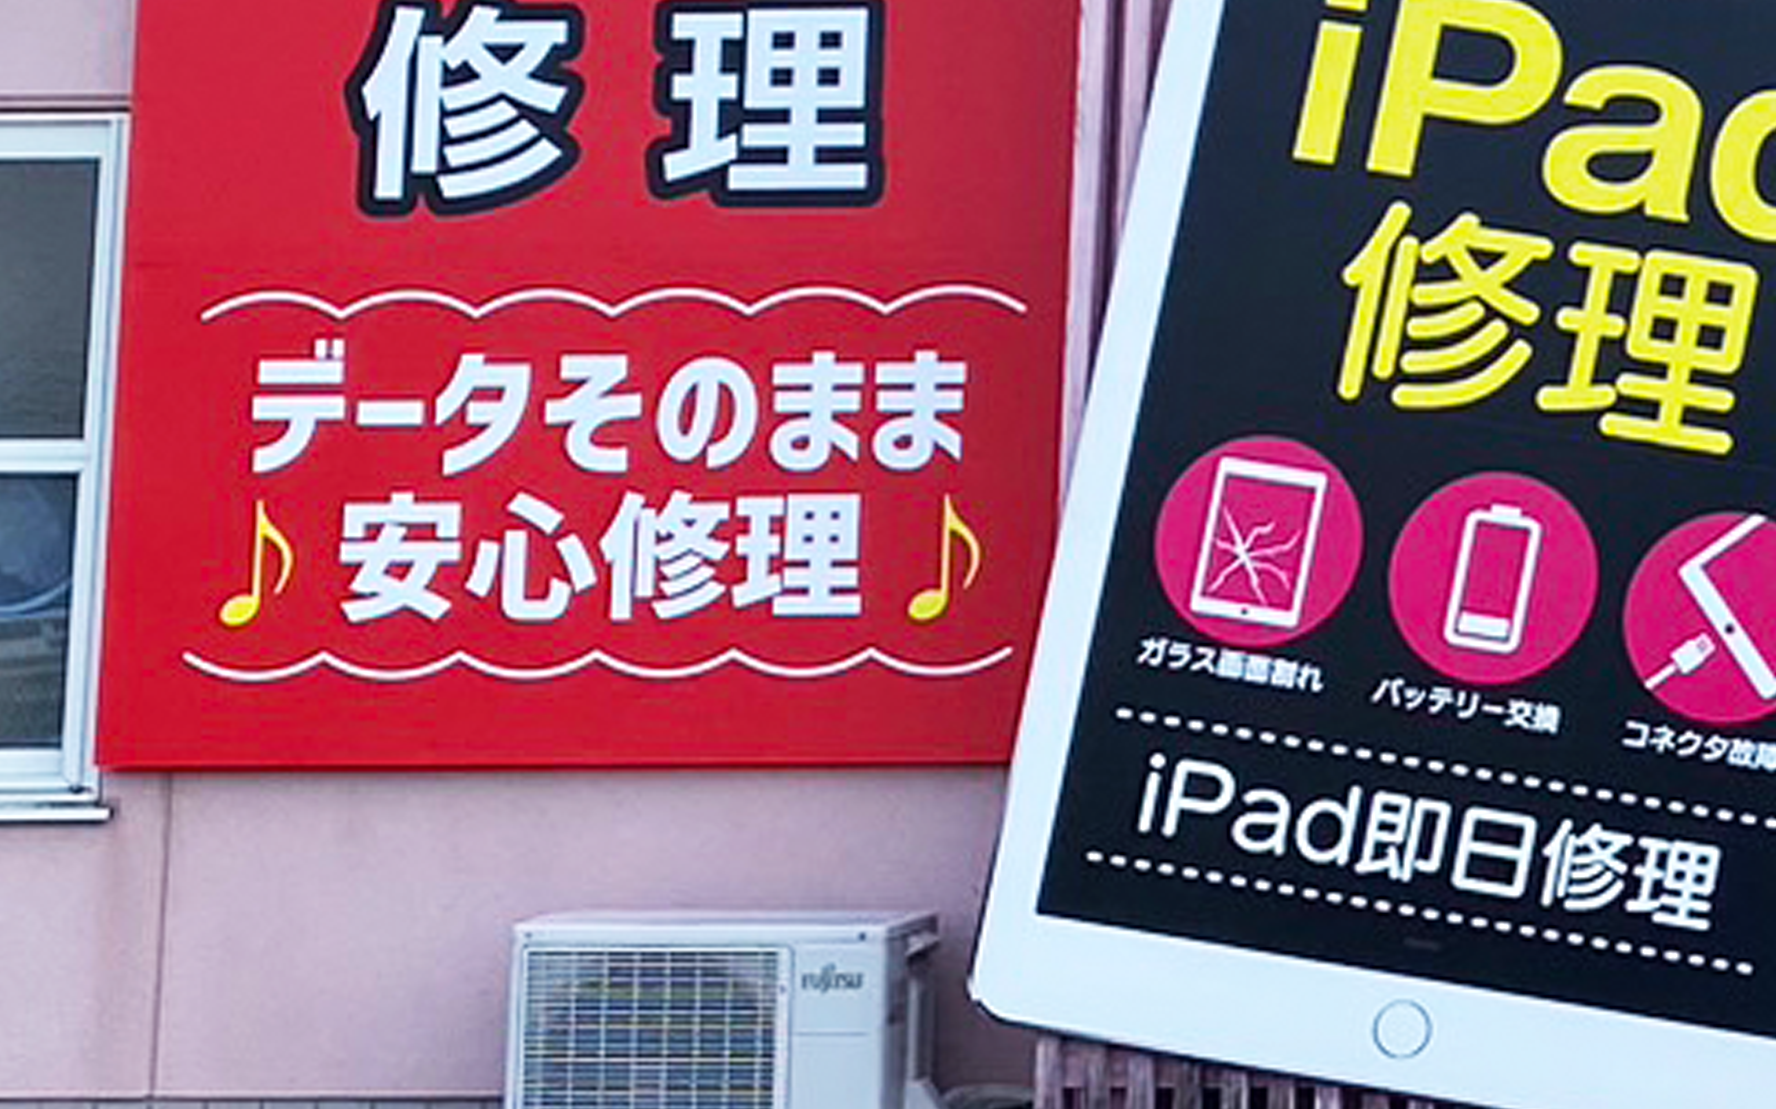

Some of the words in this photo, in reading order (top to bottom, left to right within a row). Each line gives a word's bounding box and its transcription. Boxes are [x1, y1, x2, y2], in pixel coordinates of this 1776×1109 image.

[1337, 201, 1760, 456] 修理
[251, 338, 966, 474] データそのまま
[338, 491, 861, 623] 安心修理
[1371, 678, 1563, 735] バッテリー交換
[1136, 753, 1723, 931] iPad即日修理
